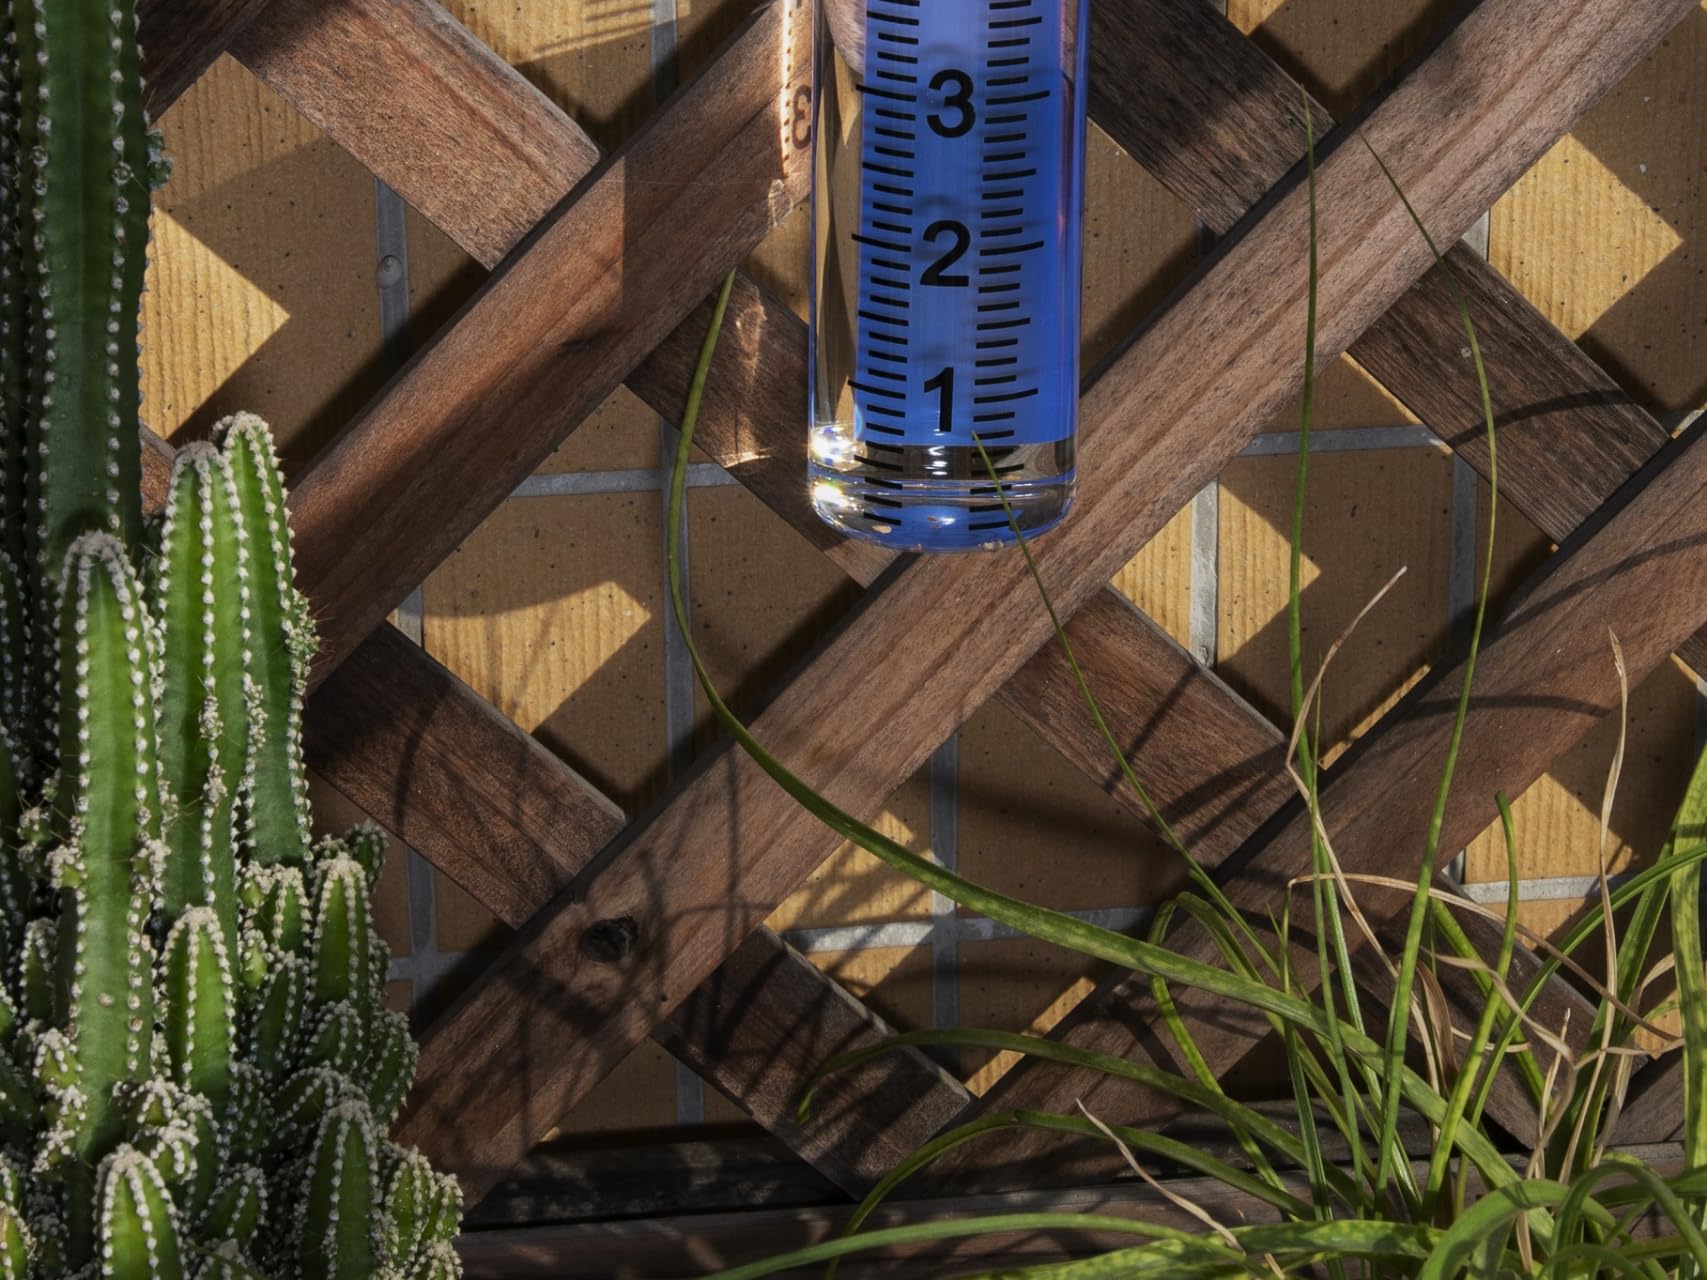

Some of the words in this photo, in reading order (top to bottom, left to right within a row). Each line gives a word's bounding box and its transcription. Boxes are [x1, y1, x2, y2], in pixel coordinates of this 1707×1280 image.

[927, 69, 976, 138] 3
[920, 220, 970, 287] 2
[923, 367, 954, 432] 1
